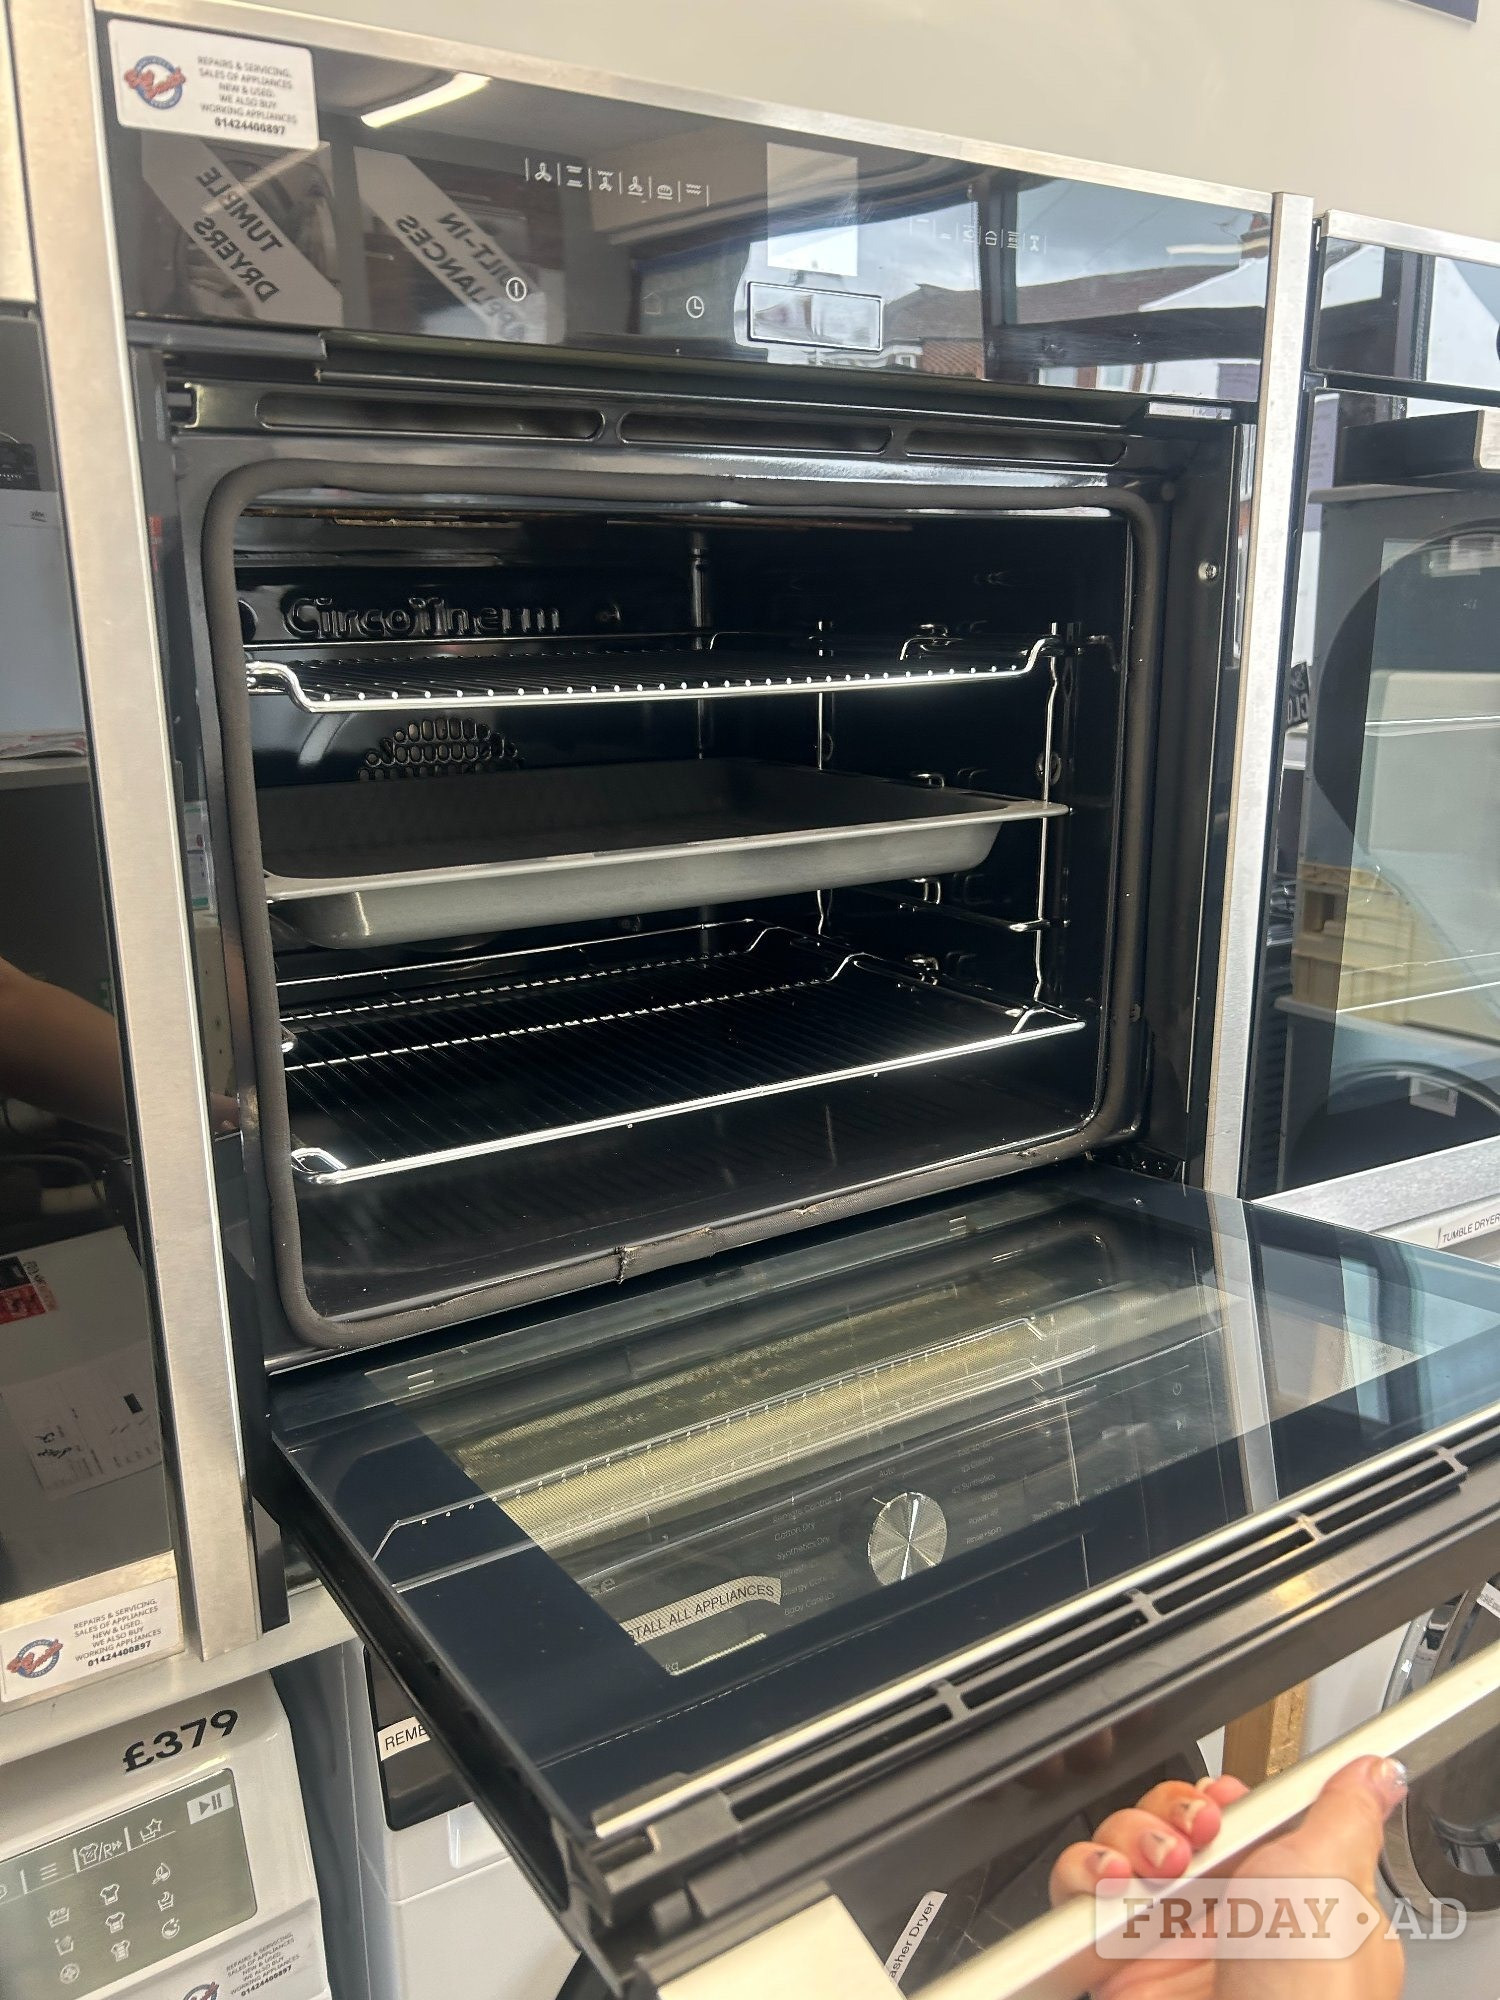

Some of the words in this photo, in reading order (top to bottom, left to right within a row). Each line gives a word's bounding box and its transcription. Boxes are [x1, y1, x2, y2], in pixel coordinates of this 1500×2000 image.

[198, 56, 234, 70] REPAIRS
[198, 67, 226, 80] SALES
[227, 72, 239, 82] OF
[240, 74, 293, 89] APPLIANCES
[219, 82, 241, 94] NEW
[242, 86, 249, 94] &
[219, 94, 234, 104] WE
[235, 96, 258, 107] ALSO
[259, 99, 277, 109] BUY
[200, 103, 245, 117] WORKING
[245, 109, 297, 124] APPLIANCES
[1443, 1223, 1473, 1243] TUMBLE
[669, 1608, 692, 1626] ALL
[694, 1584, 775, 1616] APPLIANCES
[73, 1613, 106, 1630] REPAIRS
[74, 1624, 99, 1638] SALES
[100, 1621, 111, 1630] OF
[111, 1605, 159, 1626] APPLIANCES
[92, 1628, 111, 1640] NEW
[112, 1626, 118, 1634] &
[92, 1637, 105, 1648] WE
[106, 1631, 126, 1645] ALSO
[128, 1625, 144, 1637] BUY
[75, 1642, 114, 1662] WORKING
[115, 1628, 162, 1649] APPLIANCES
[87, 1640, 152, 1667] 01424400897
[122, 1709, 239, 1774] £379
[889, 1941, 912, 1978] asher
[909, 1900, 935, 1937] Dryer
